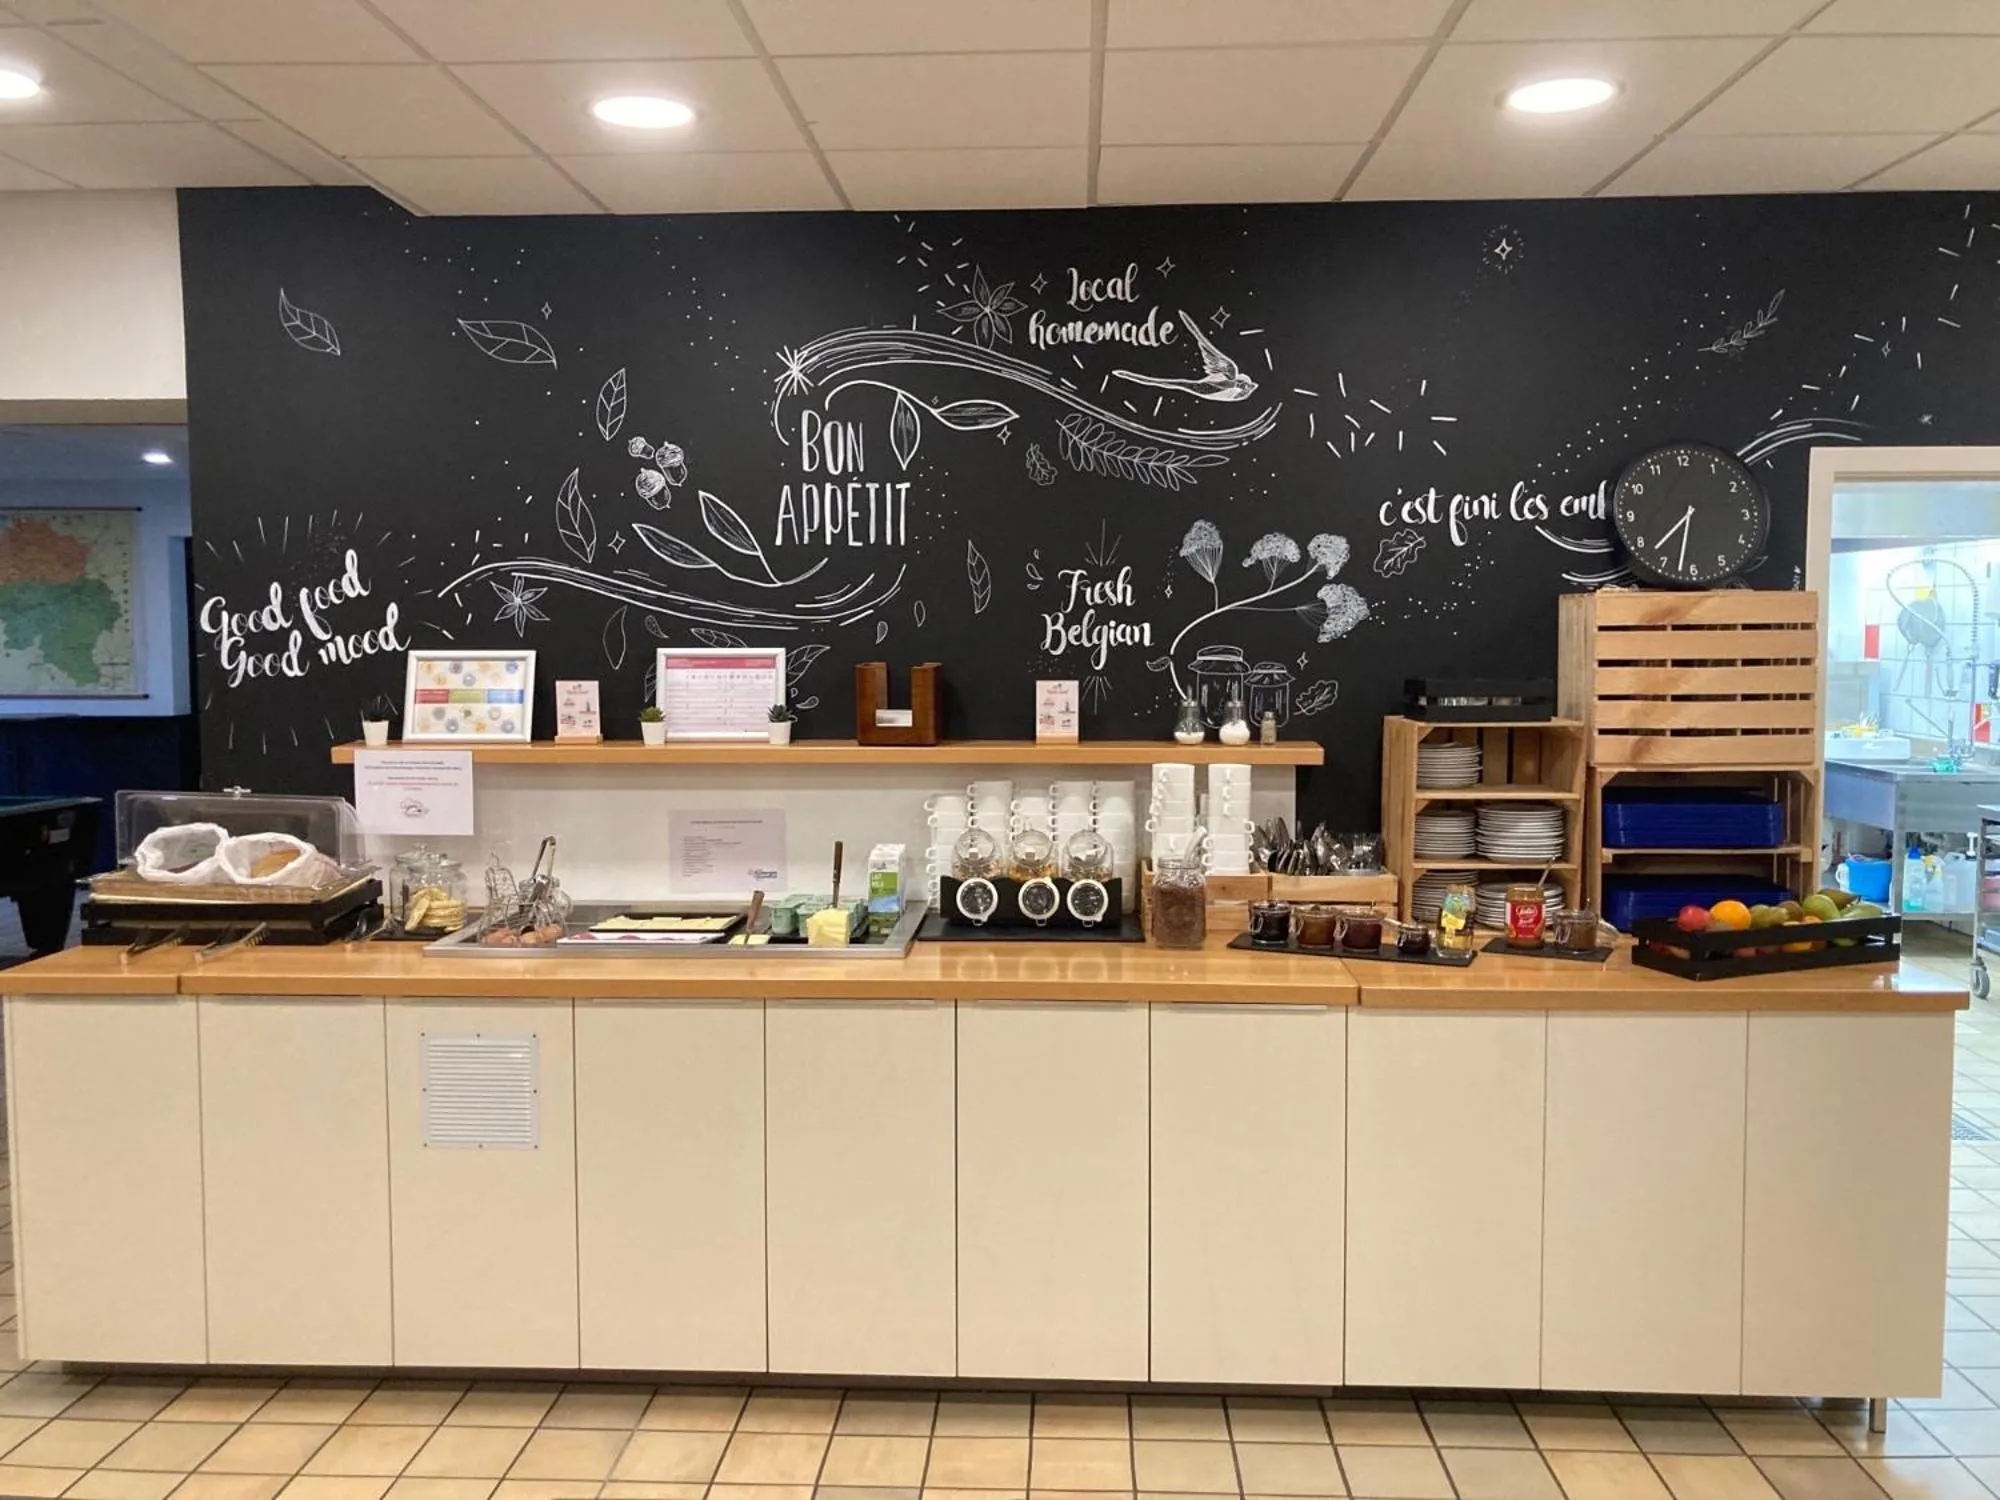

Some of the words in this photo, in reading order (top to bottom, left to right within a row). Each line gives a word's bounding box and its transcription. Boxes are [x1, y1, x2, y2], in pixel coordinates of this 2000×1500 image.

[1066, 262, 1140, 312] Local
[1028, 305, 1179, 350] homemade
[801, 409, 864, 476] BON
[1677, 455, 1690, 467] 12
[1650, 464, 1661, 476] 11
[1710, 463, 1716, 475] 1
[1631, 483, 1644, 495] 10
[1729, 481, 1737, 493] 2
[1449, 493, 1502, 547] fini
[1509, 480, 1550, 521] les
[1626, 510, 1635, 522] 9
[1741, 508, 1750, 521] 3
[1636, 536, 1645, 548] 8
[1738, 533, 1745, 545] 4
[1660, 556, 1668, 568] 7
[1717, 555, 1726, 567] 5
[1689, 564, 1698, 576] 6
[1057, 565, 1136, 614] Fresh
[200, 581, 294, 650] Good
[299, 548, 372, 641] food
[220, 629, 311, 689] Good
[317, 602, 412, 665] mood
[1040, 608, 1155, 671] Belgian
